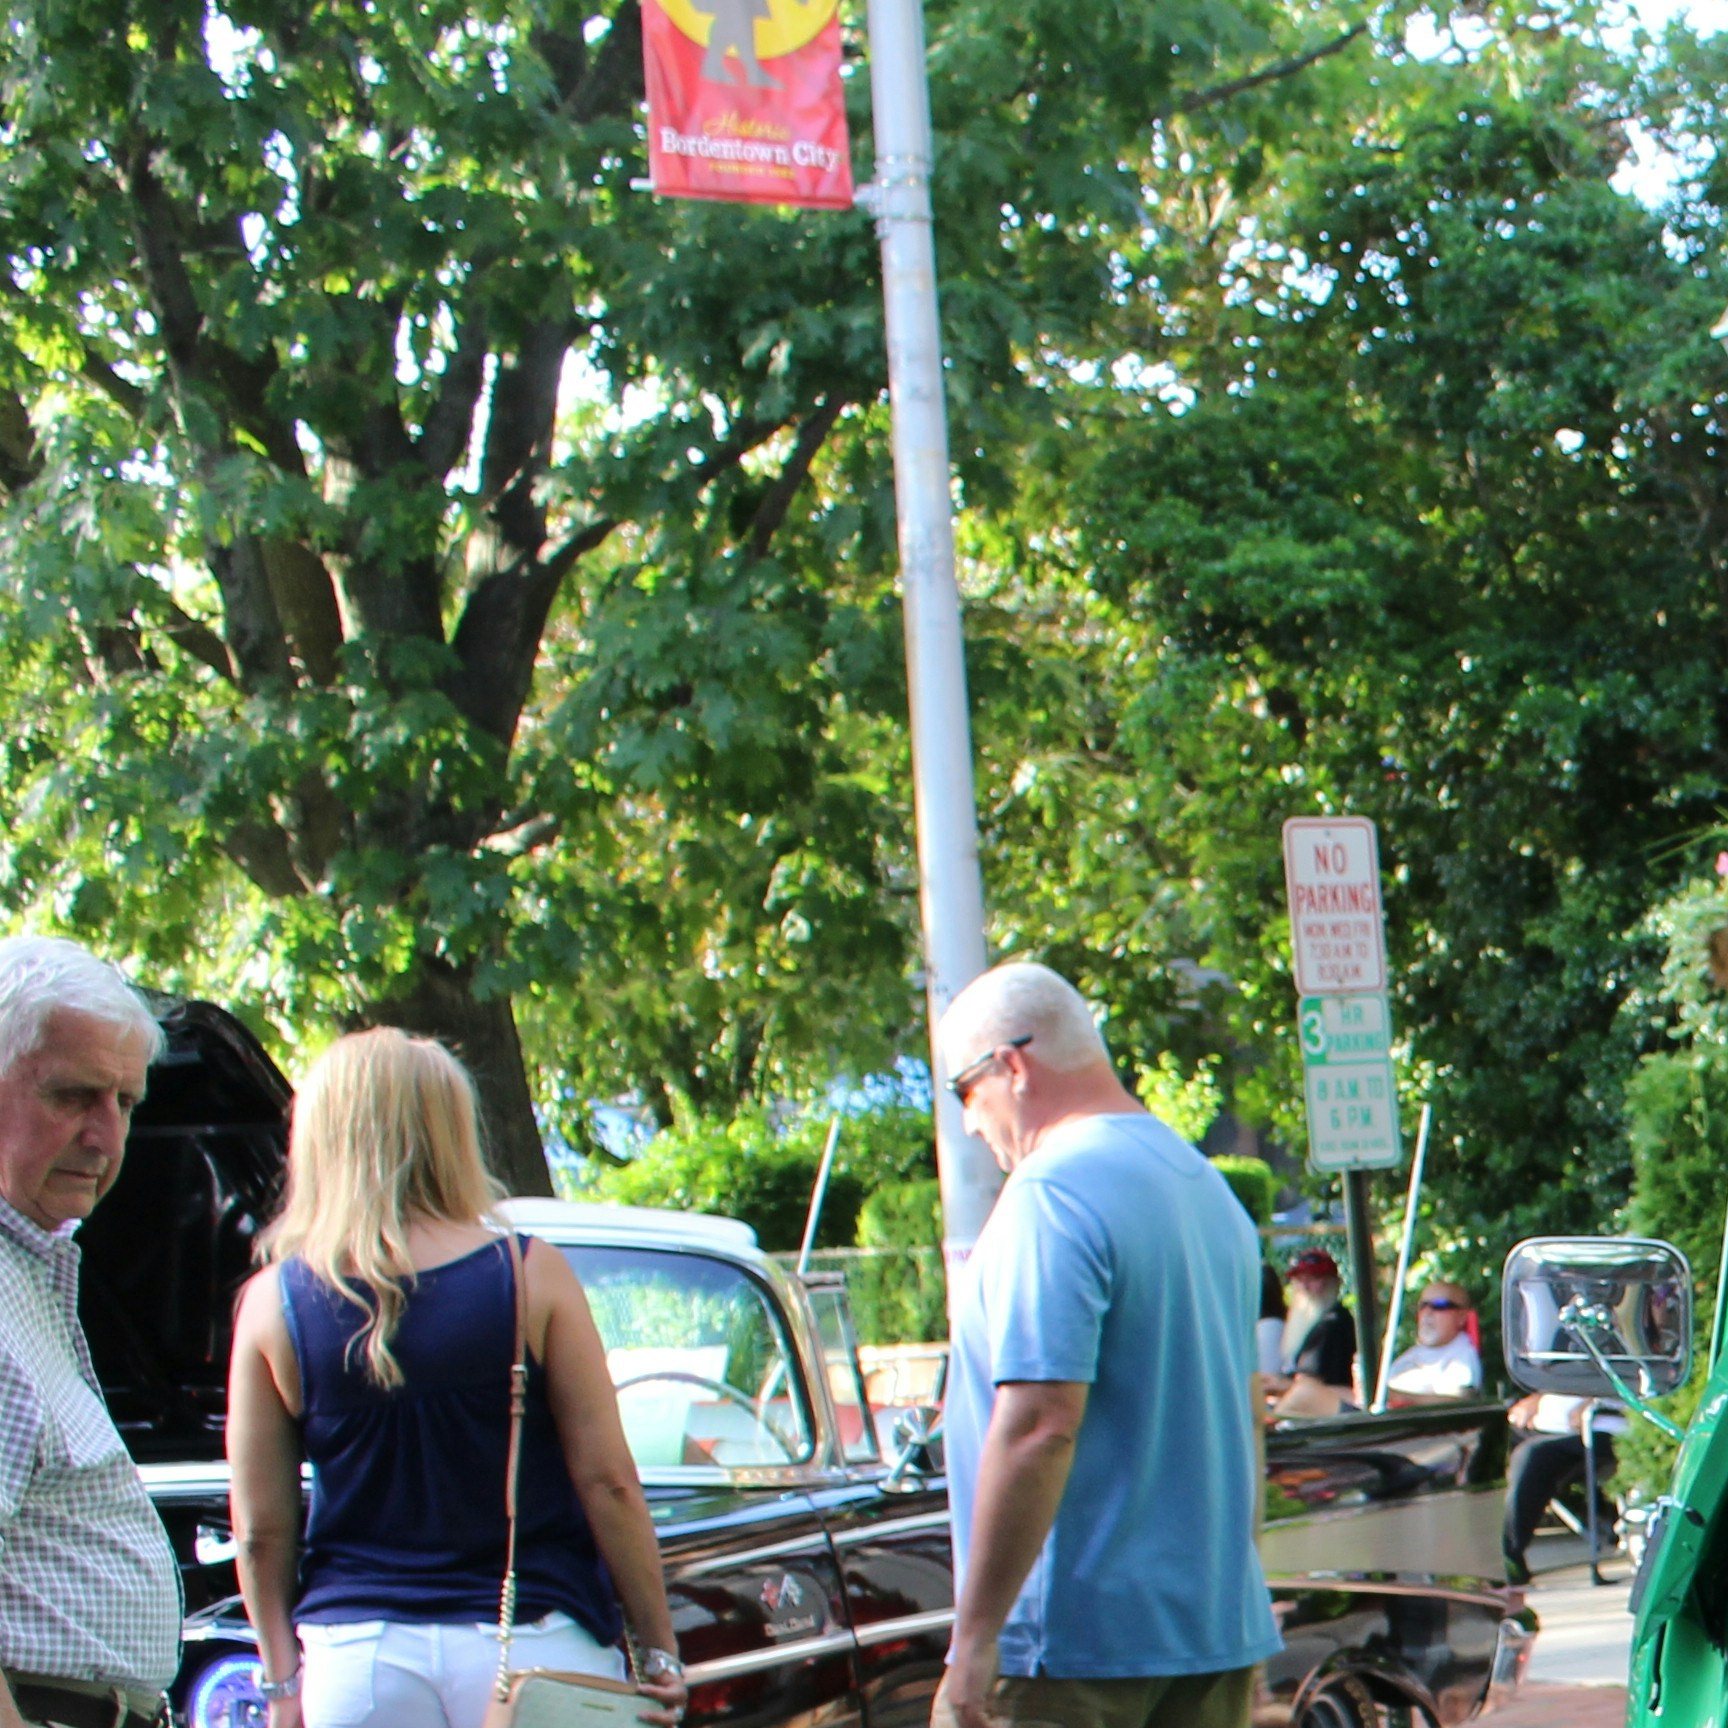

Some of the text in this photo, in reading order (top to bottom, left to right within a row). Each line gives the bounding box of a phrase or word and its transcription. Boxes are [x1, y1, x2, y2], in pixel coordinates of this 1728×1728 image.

[660, 126, 789, 165] Bordentown
[793, 139, 841, 173] City
[1314, 844, 1347, 875] NO
[1295, 883, 1374, 914] PARKING
[1341, 1004, 1364, 1024] HR
[1303, 1010, 1326, 1055] 3
[1326, 1031, 1387, 1053] PARKING
[1317, 1078, 1328, 1102] 8
[1366, 1076, 1384, 1099] TO
[1329, 1107, 1341, 1130] 6
